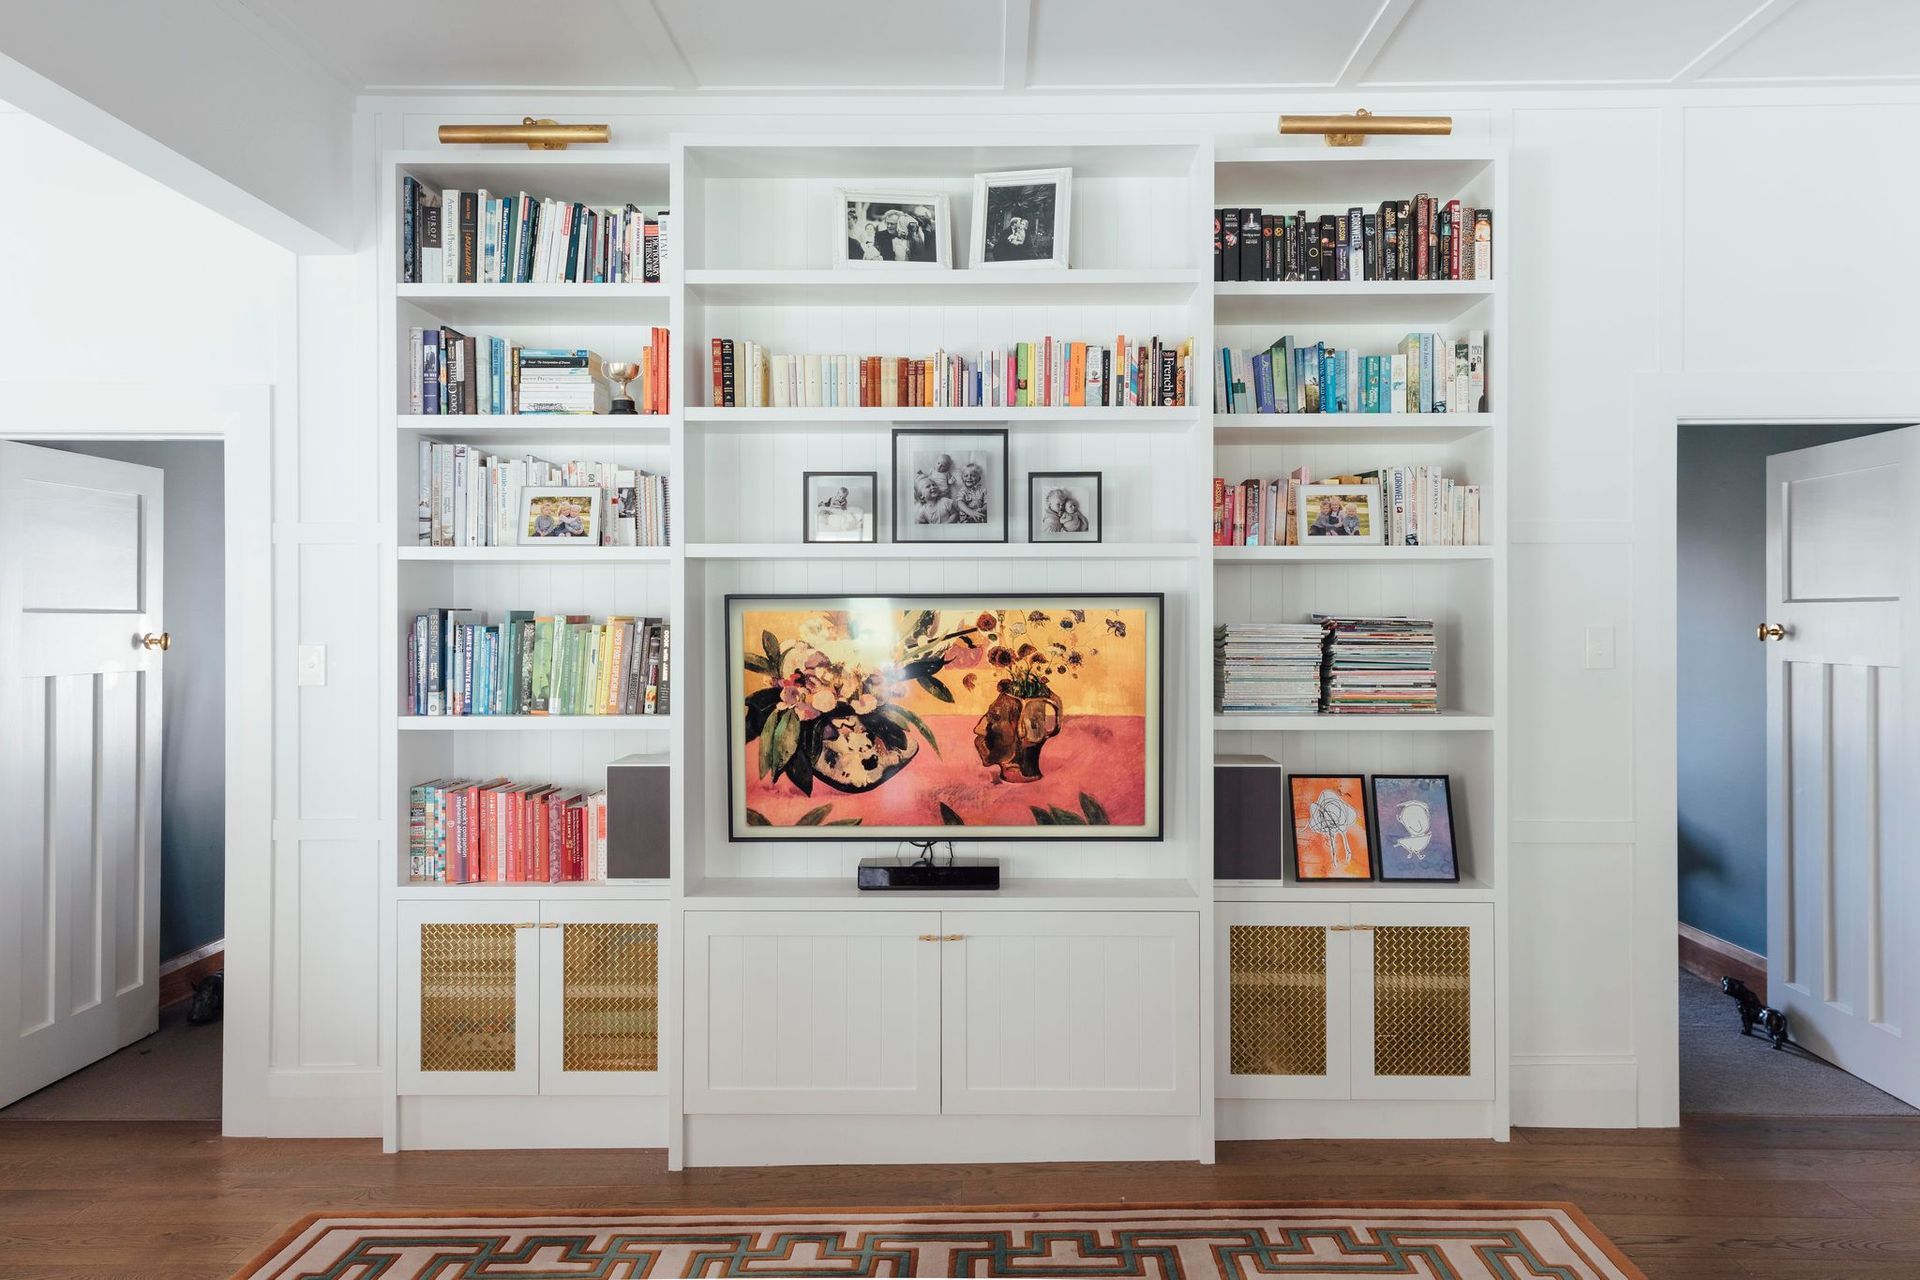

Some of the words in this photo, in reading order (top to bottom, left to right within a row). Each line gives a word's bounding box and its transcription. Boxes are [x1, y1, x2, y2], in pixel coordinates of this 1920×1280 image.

[446, 198, 455, 229] Anatomy
[1352, 214, 1360, 246] CORNWELL
[446, 234, 455, 267] Physiology
[448, 361, 456, 393] Chanel
[1164, 358, 1174, 391] French
[500, 466, 508, 487] jamie
[1394, 472, 1403, 505] CORNWELL
[430, 615, 438, 658] ESSENTIAL
[630, 674, 638, 701] BARBECUE
